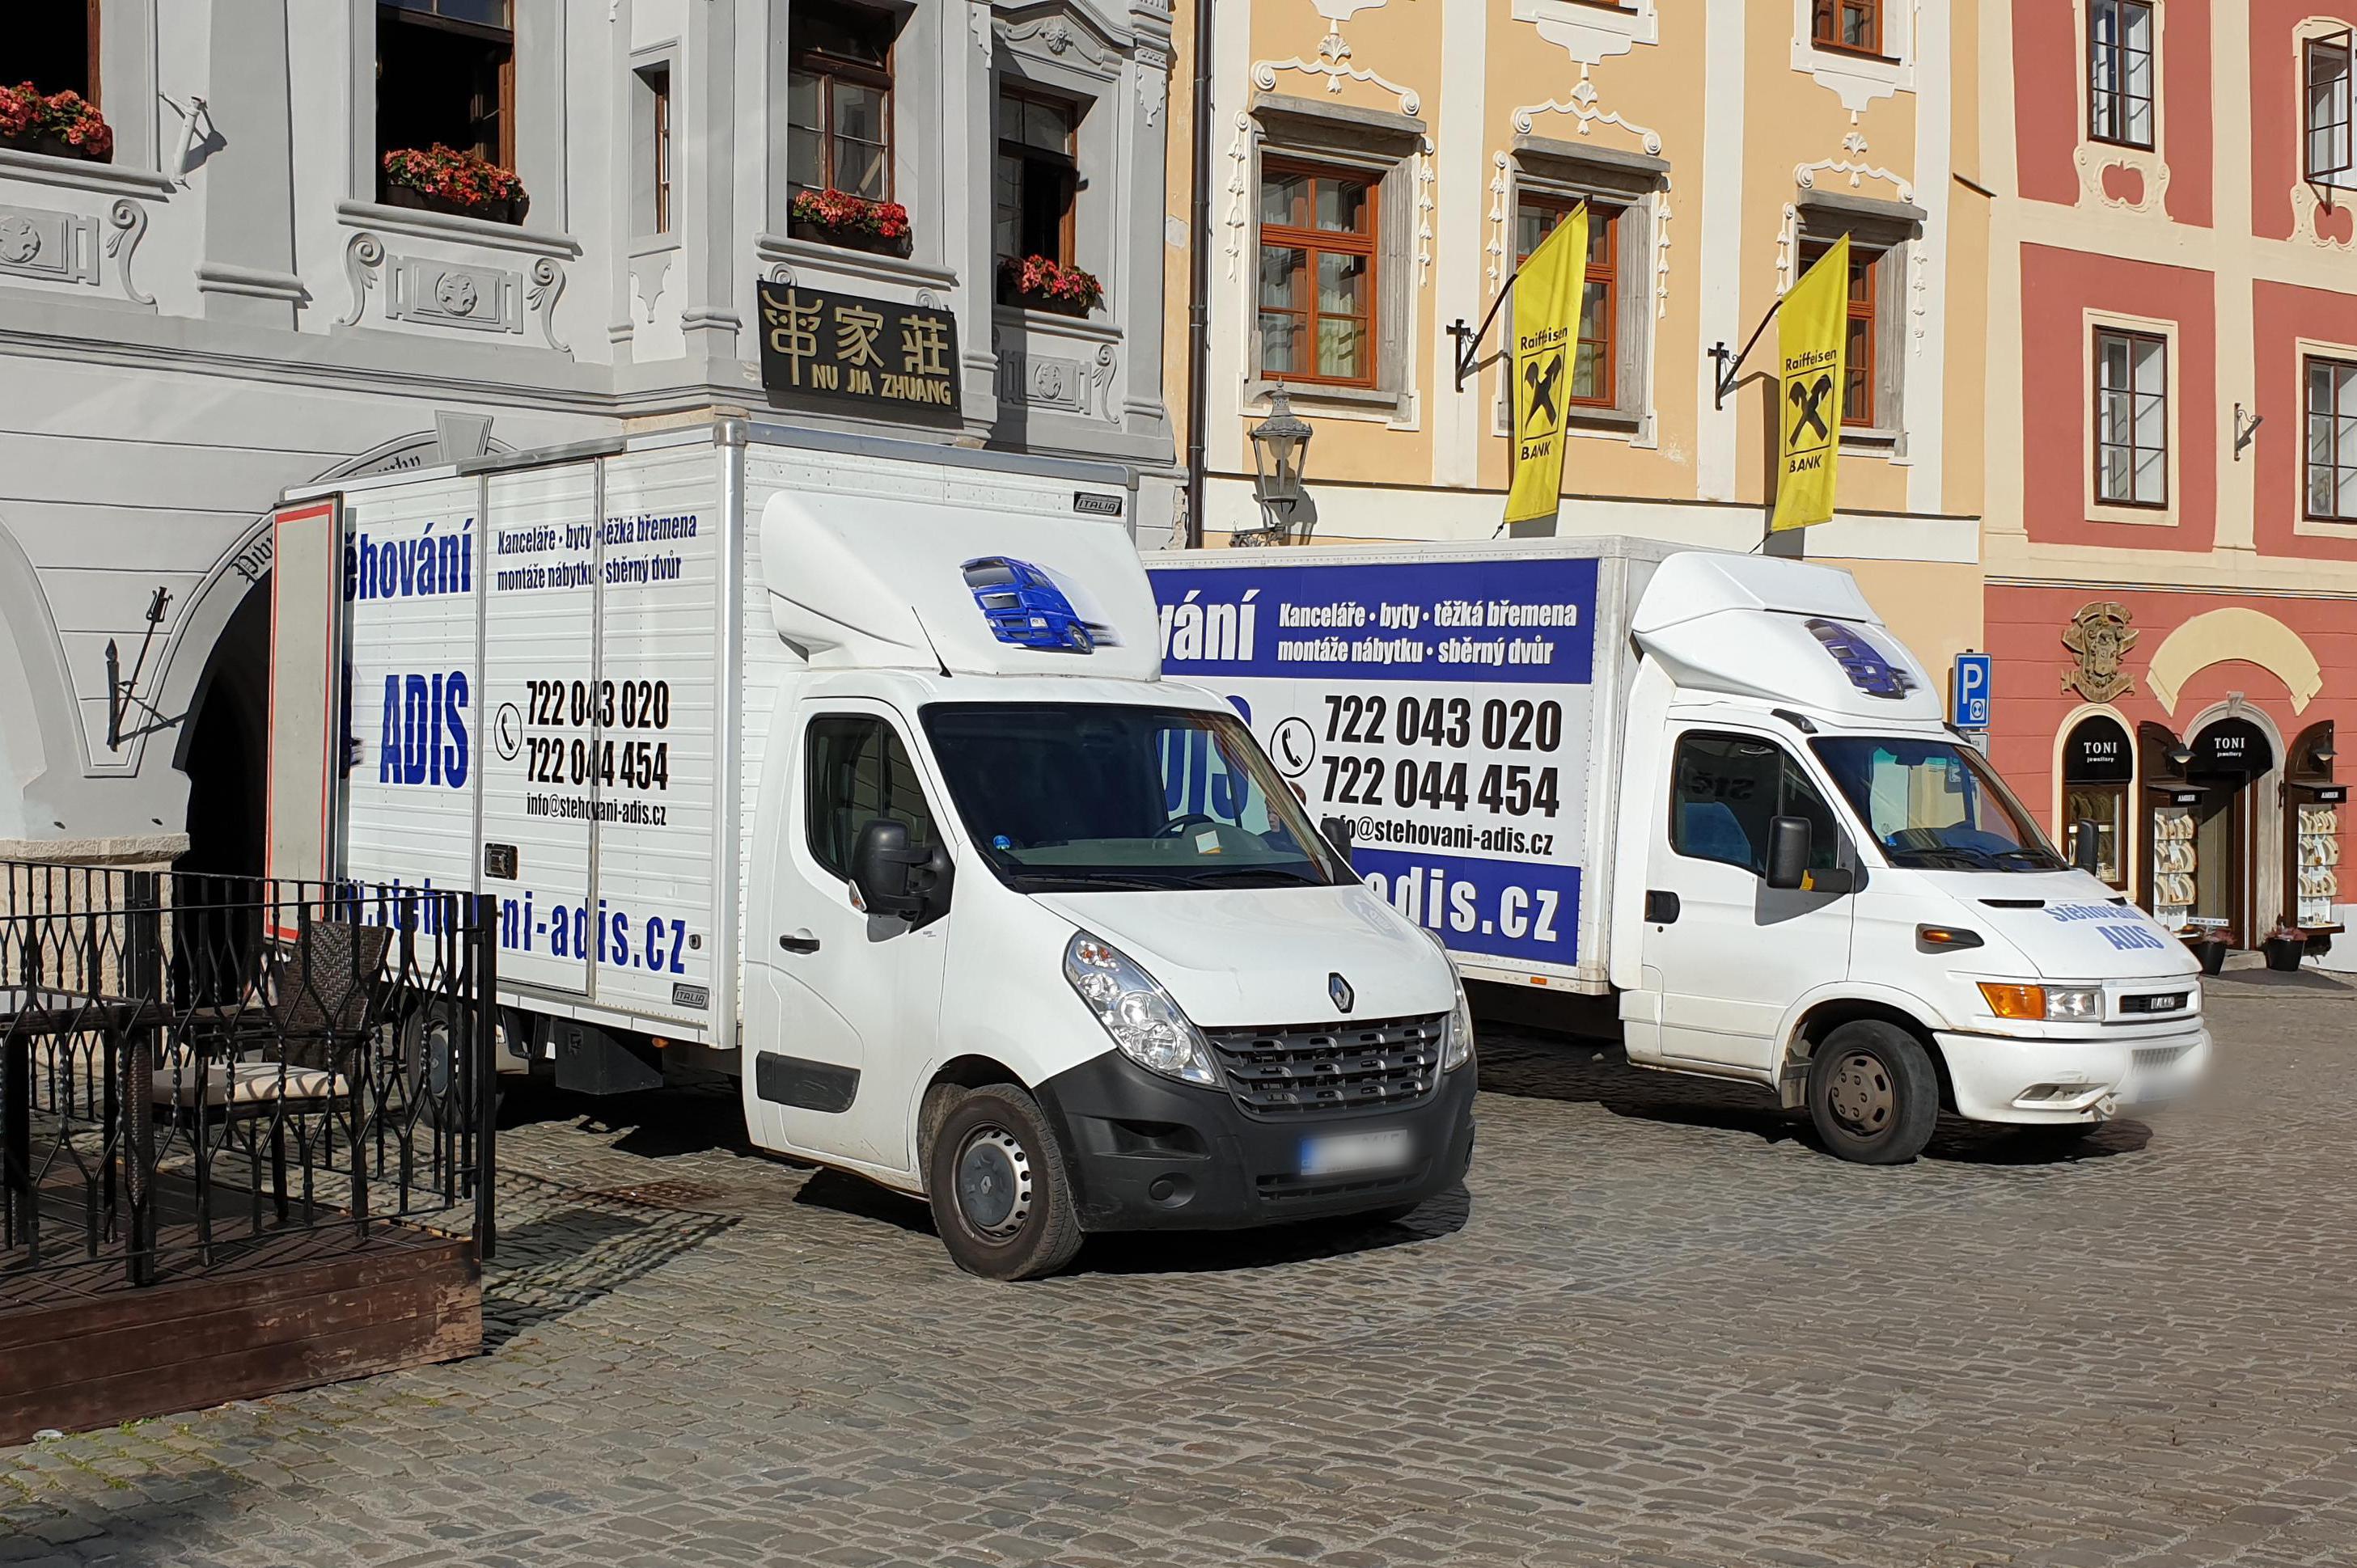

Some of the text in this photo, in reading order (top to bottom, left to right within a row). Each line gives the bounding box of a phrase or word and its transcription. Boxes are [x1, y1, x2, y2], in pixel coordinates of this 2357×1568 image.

[1521, 327, 1568, 350] Raiffeisen
[1786, 349, 1837, 371] Raiffeisen
[812, 364, 951, 405] NU JIA ZHUANG
[1521, 442, 1551, 461] BANK
[1789, 454, 1822, 473] BANK
[1079, 500, 1116, 511] ITALIA
[497, 514, 697, 556] Kanceláře byty těžká břemena
[497, 549, 682, 591] montáže nábytku sběrný dvůr
[1279, 599, 1577, 630] Kanceláře byty těžká břemena
[1277, 635, 1554, 666] montáže nábytku sběrný dvůr
[1962, 663, 1983, 704] P
[527, 680, 669, 729] 722 043 020
[379, 670, 469, 789] ADIS
[1324, 695, 1562, 752] 722 043 020
[2084, 742, 2118, 754] TONI
[2214, 737, 2245, 749] TONI
[527, 738, 669, 791] 722 044 454
[1322, 755, 1560, 818] 722 044 454
[527, 792, 667, 826] info@stehovani-adis.cz
[2095, 925, 2165, 951] ADIS
[676, 991, 705, 1004] ITALIA
